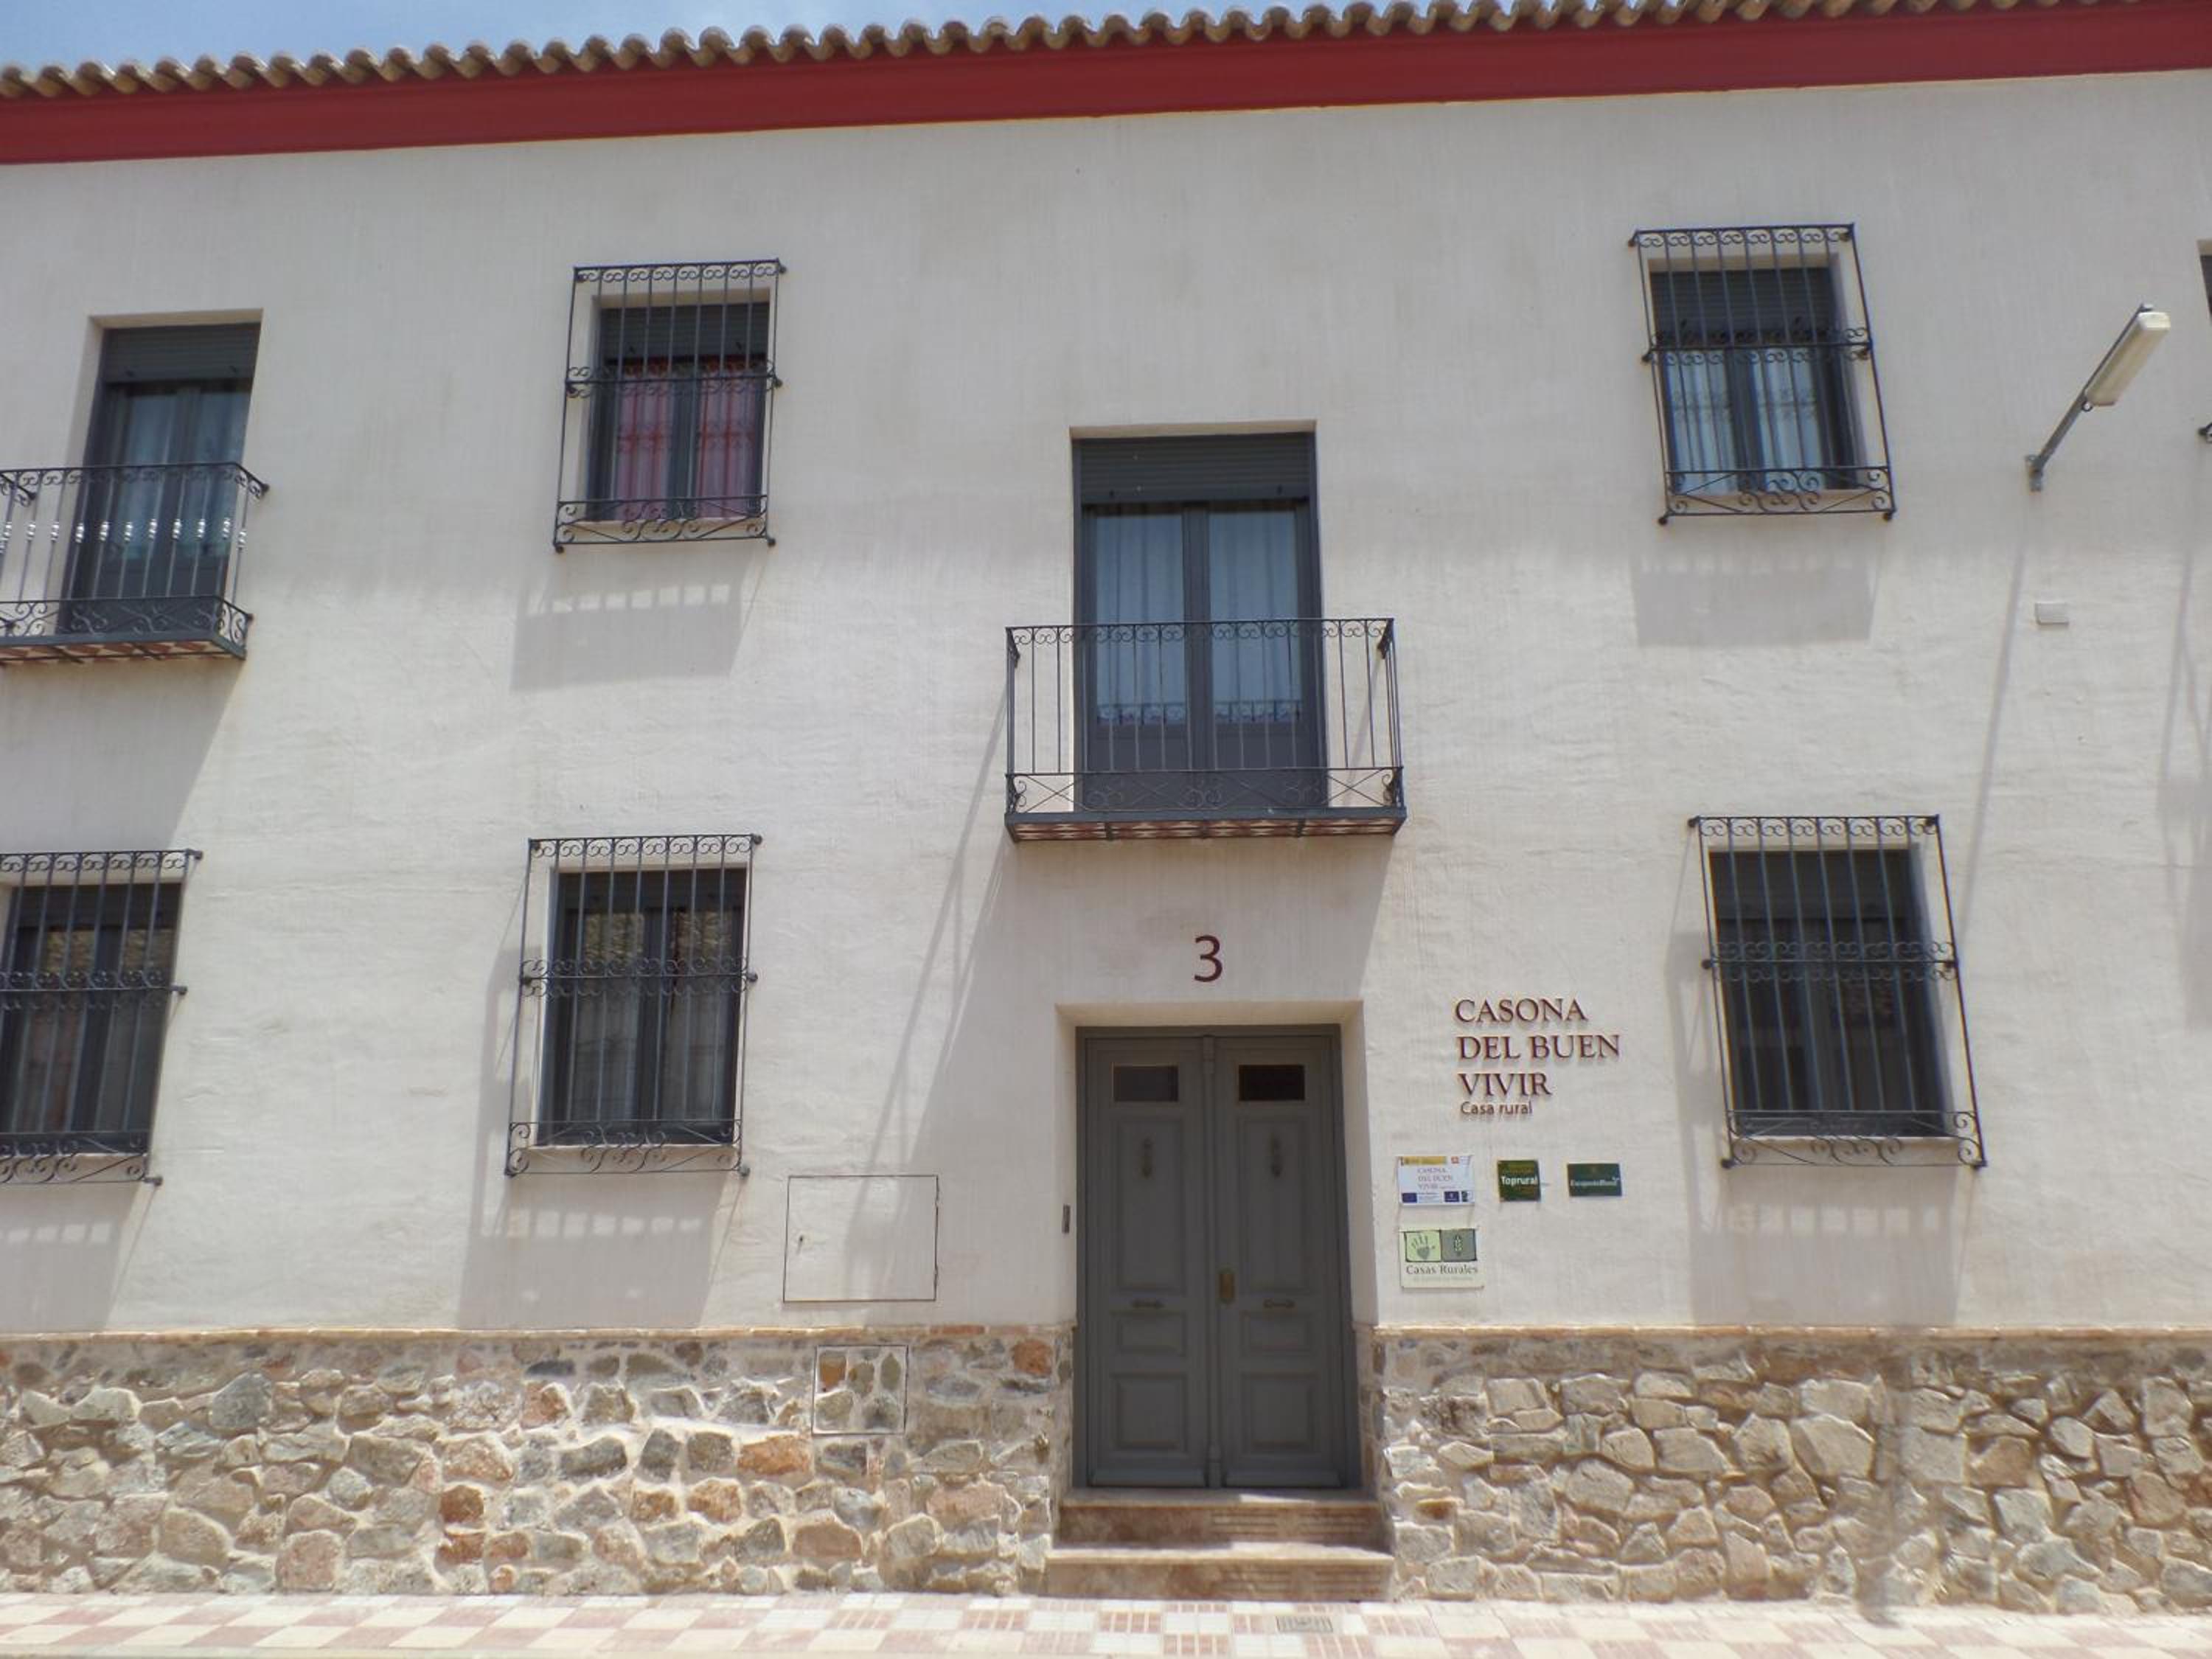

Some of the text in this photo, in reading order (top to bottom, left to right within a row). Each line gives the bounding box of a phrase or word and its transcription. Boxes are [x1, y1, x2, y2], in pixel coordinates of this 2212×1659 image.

[1194, 935, 1223, 983] 3
[1455, 998, 1589, 1023] CASONA
[1456, 1034, 1620, 1060] DEL BUEN
[1458, 1073, 1553, 1097] VIVIR
[1461, 1100, 1533, 1115] Casa rural
[1405, 1264, 1478, 1275] Casas Rurales
